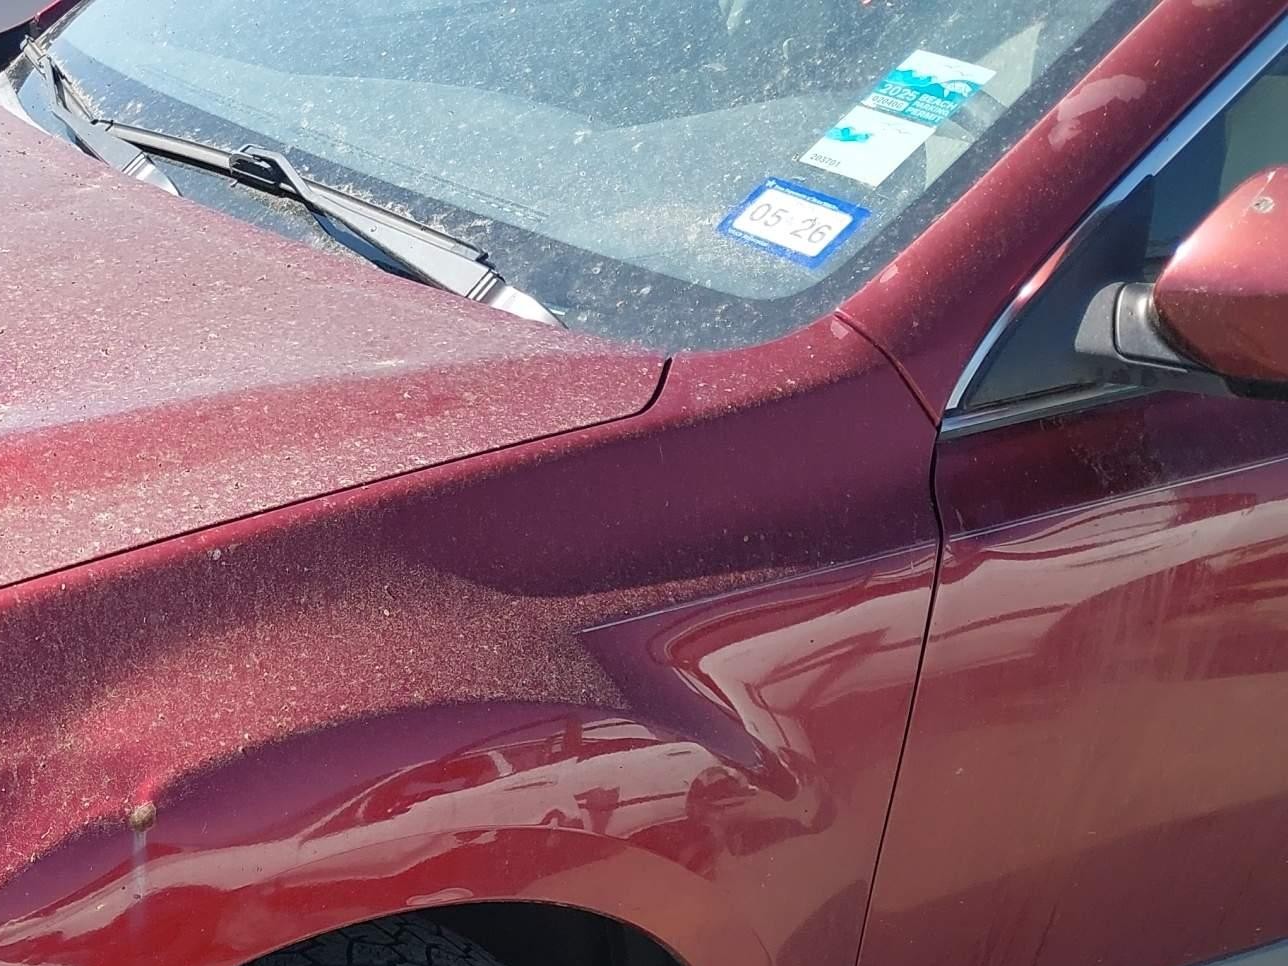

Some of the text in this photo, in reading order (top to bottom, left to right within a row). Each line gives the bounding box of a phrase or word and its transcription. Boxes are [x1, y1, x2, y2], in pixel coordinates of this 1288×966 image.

[879, 83, 920, 102] 2025
[911, 101, 950, 117] PARKING
[918, 93, 958, 111] BEACH
[904, 106, 945, 122] PERMIT
[748, 203, 790, 228] 05
[788, 216, 833, 244] 26
